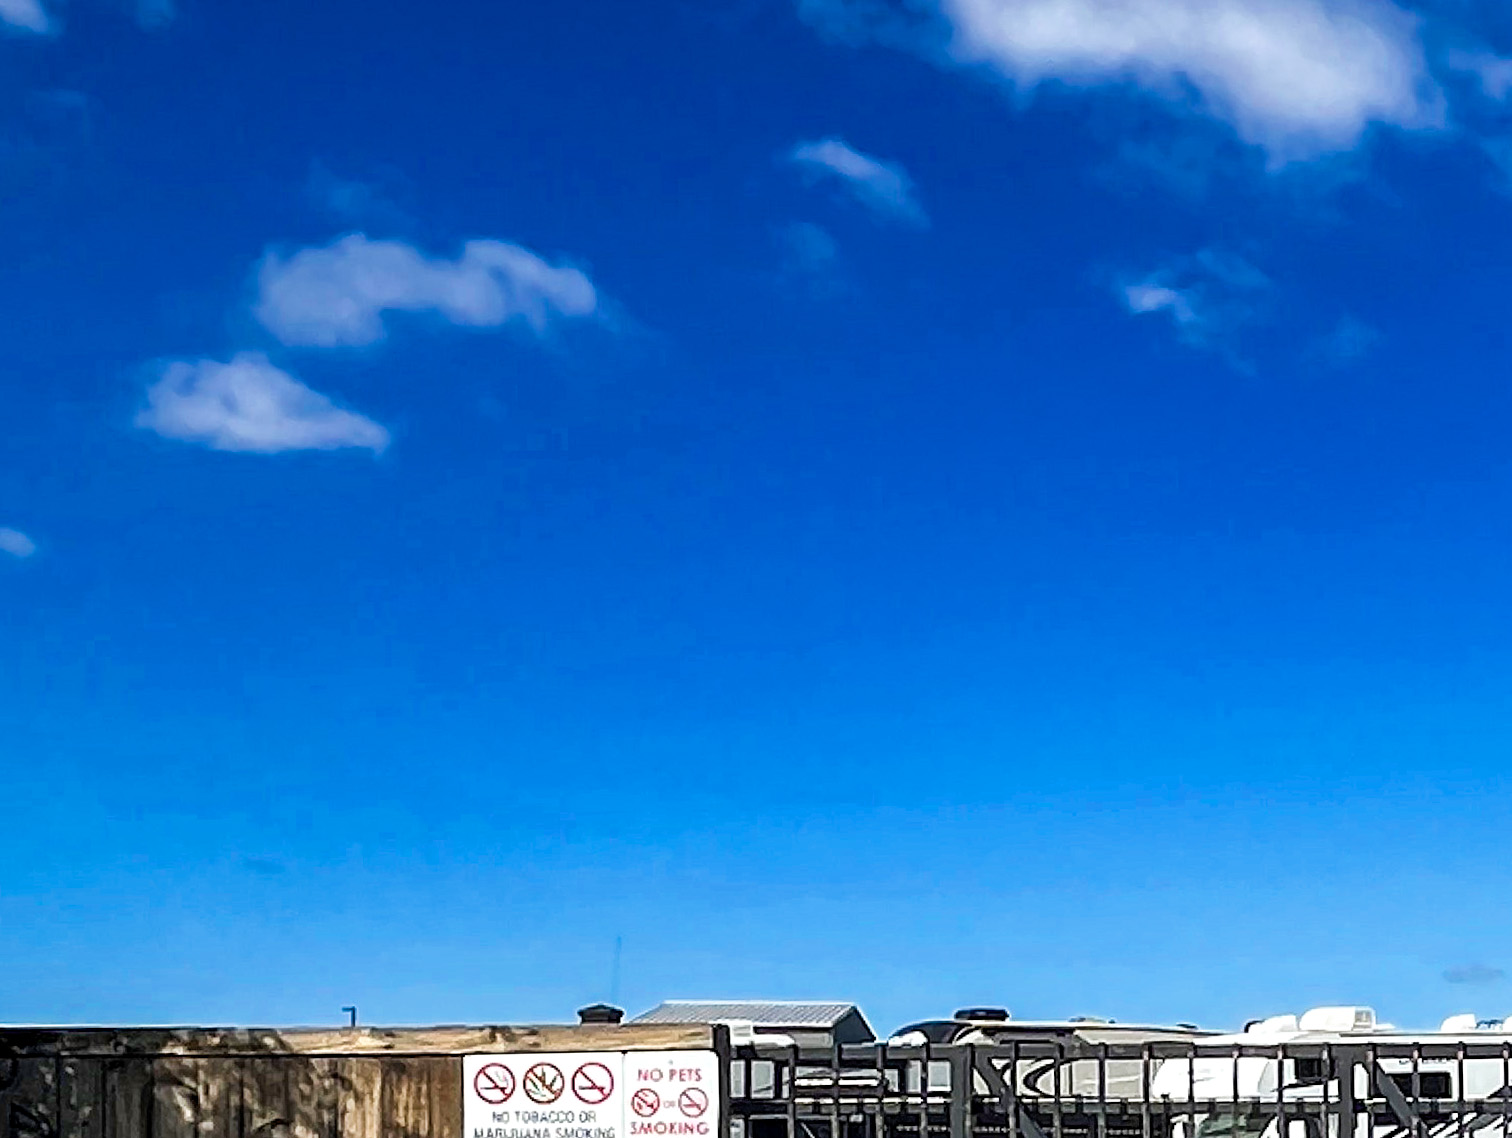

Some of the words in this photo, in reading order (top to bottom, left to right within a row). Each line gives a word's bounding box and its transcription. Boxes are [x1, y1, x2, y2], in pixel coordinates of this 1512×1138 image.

[637, 1068, 663, 1082] NO
[669, 1068, 702, 1082] PETS
[492, 1111, 509, 1123] NO
[515, 1111, 575, 1123] TOBACCO
[579, 1110, 597, 1123] OR
[630, 1121, 709, 1135] SMOKING
